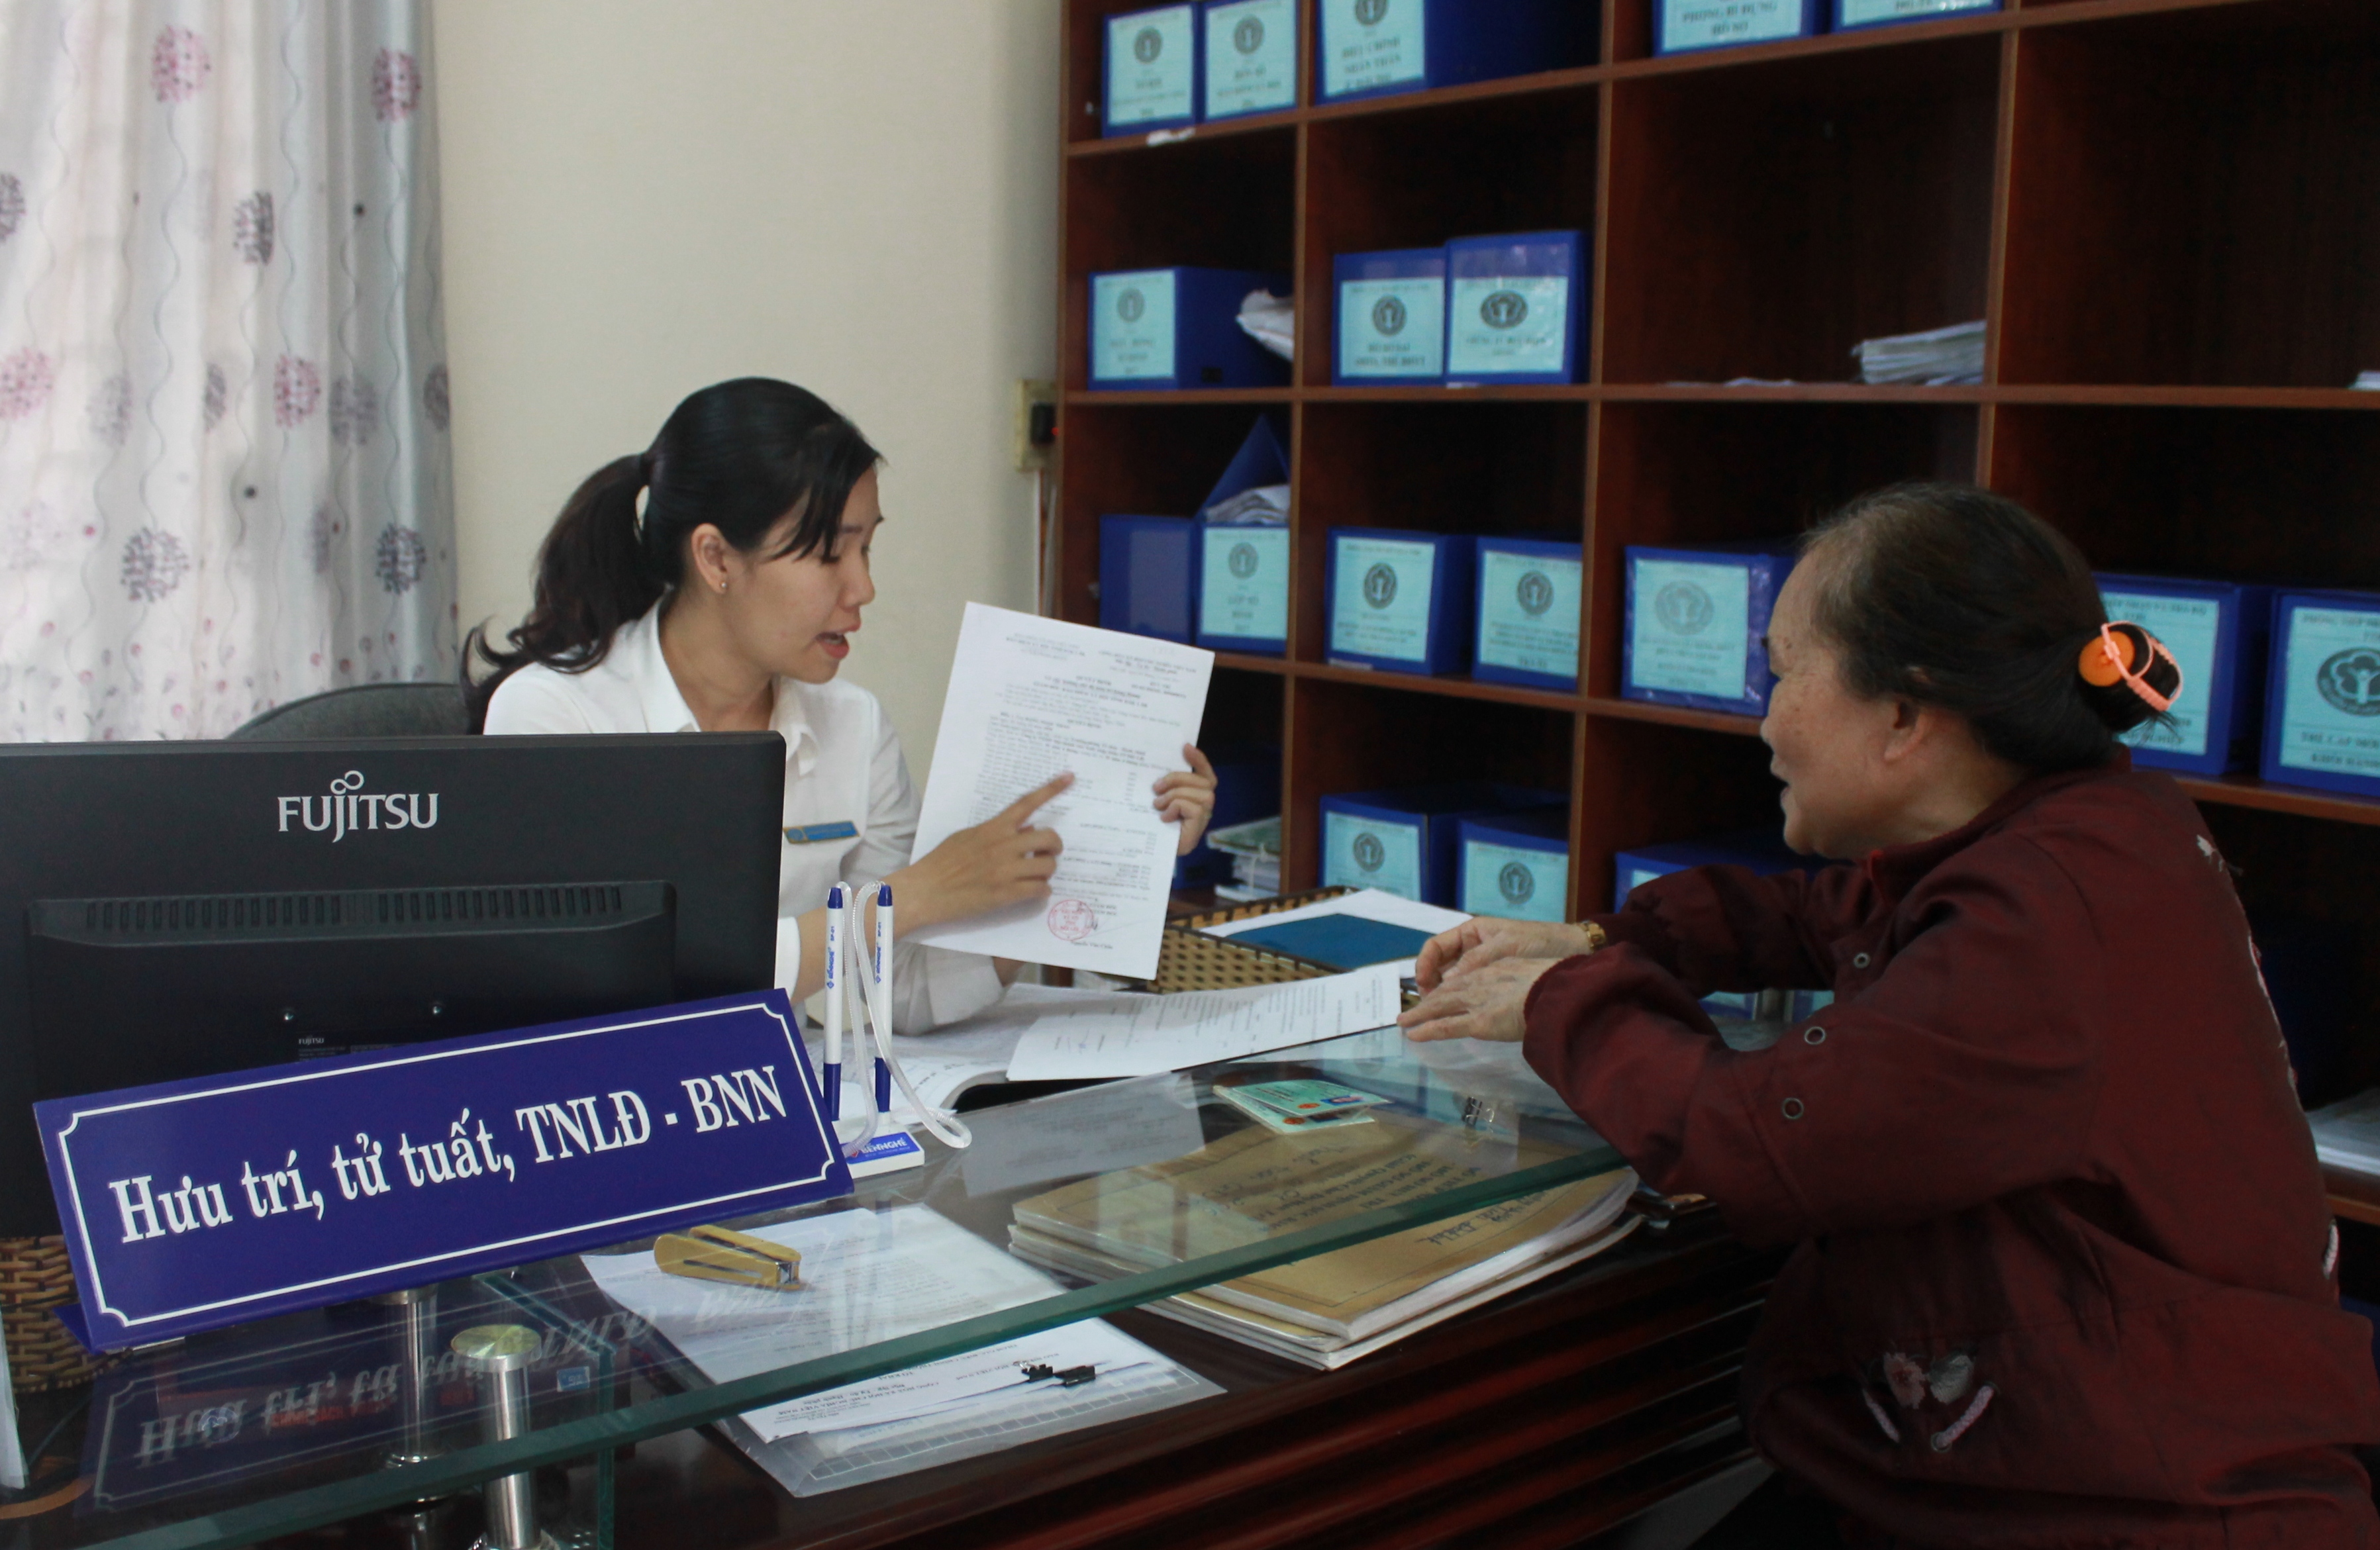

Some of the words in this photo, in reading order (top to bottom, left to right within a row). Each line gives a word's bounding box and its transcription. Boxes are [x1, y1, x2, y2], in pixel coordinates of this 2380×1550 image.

[277, 770, 440, 844] FUJITSU
[108, 1175, 234, 1244] Hưu
[240, 1149, 325, 1221] trí,
[331, 1132, 391, 1201] tử
[399, 1107, 516, 1188] tuất,
[515, 1089, 652, 1164] TNLĐ
[680, 1065, 787, 1134] BNN
